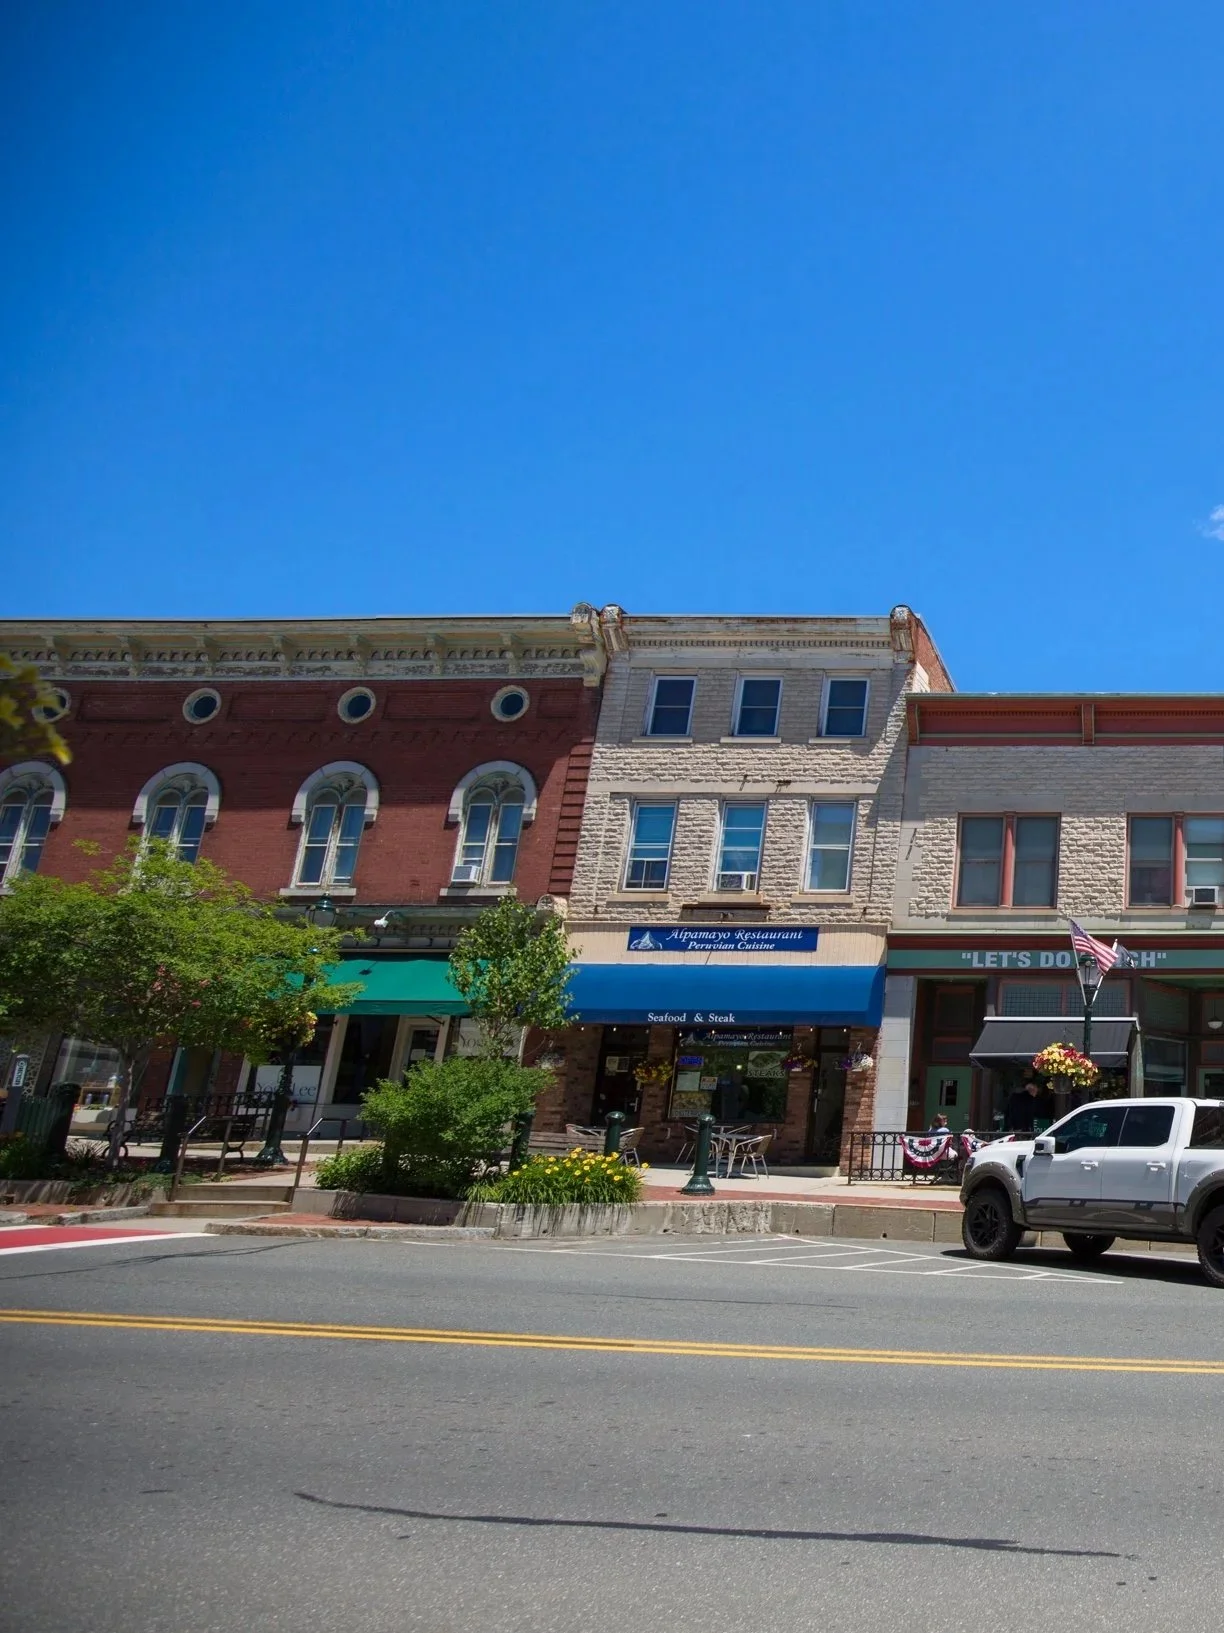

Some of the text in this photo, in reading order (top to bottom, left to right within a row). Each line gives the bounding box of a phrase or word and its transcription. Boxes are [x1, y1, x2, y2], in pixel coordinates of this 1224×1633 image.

[666, 928, 803, 942] Alpamayo Restaurant
[687, 942, 776, 950] Peruvian Cuisine
[961, 951, 1031, 968] "LET'S
[1039, 951, 1071, 968] DO
[647, 1012, 735, 1022] Seafood & Steak
[291, 1082, 317, 1097] Lee
